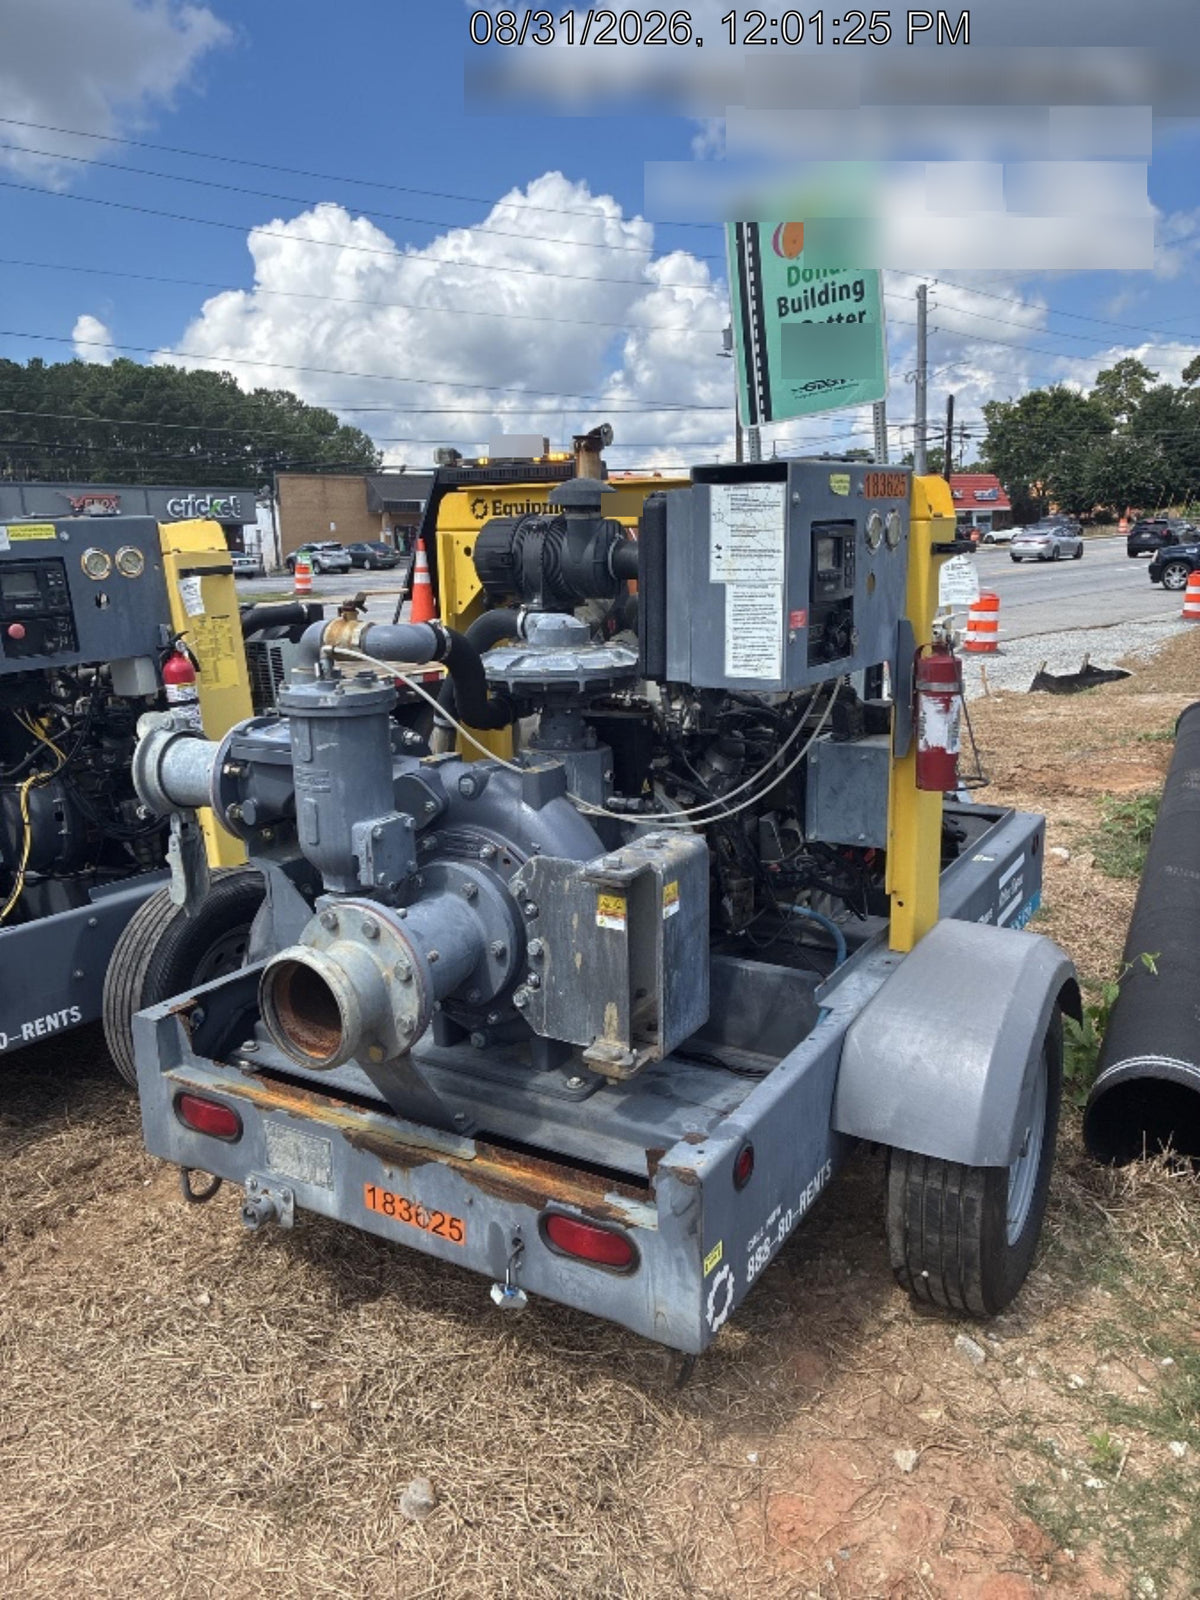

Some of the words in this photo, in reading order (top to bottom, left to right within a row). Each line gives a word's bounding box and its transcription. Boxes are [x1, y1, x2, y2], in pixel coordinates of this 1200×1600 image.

[776, 279, 865, 318] Building
[865, 473, 907, 498] 183625
[167, 493, 241, 518] cricket
[367, 1186, 464, 1242] 183625
